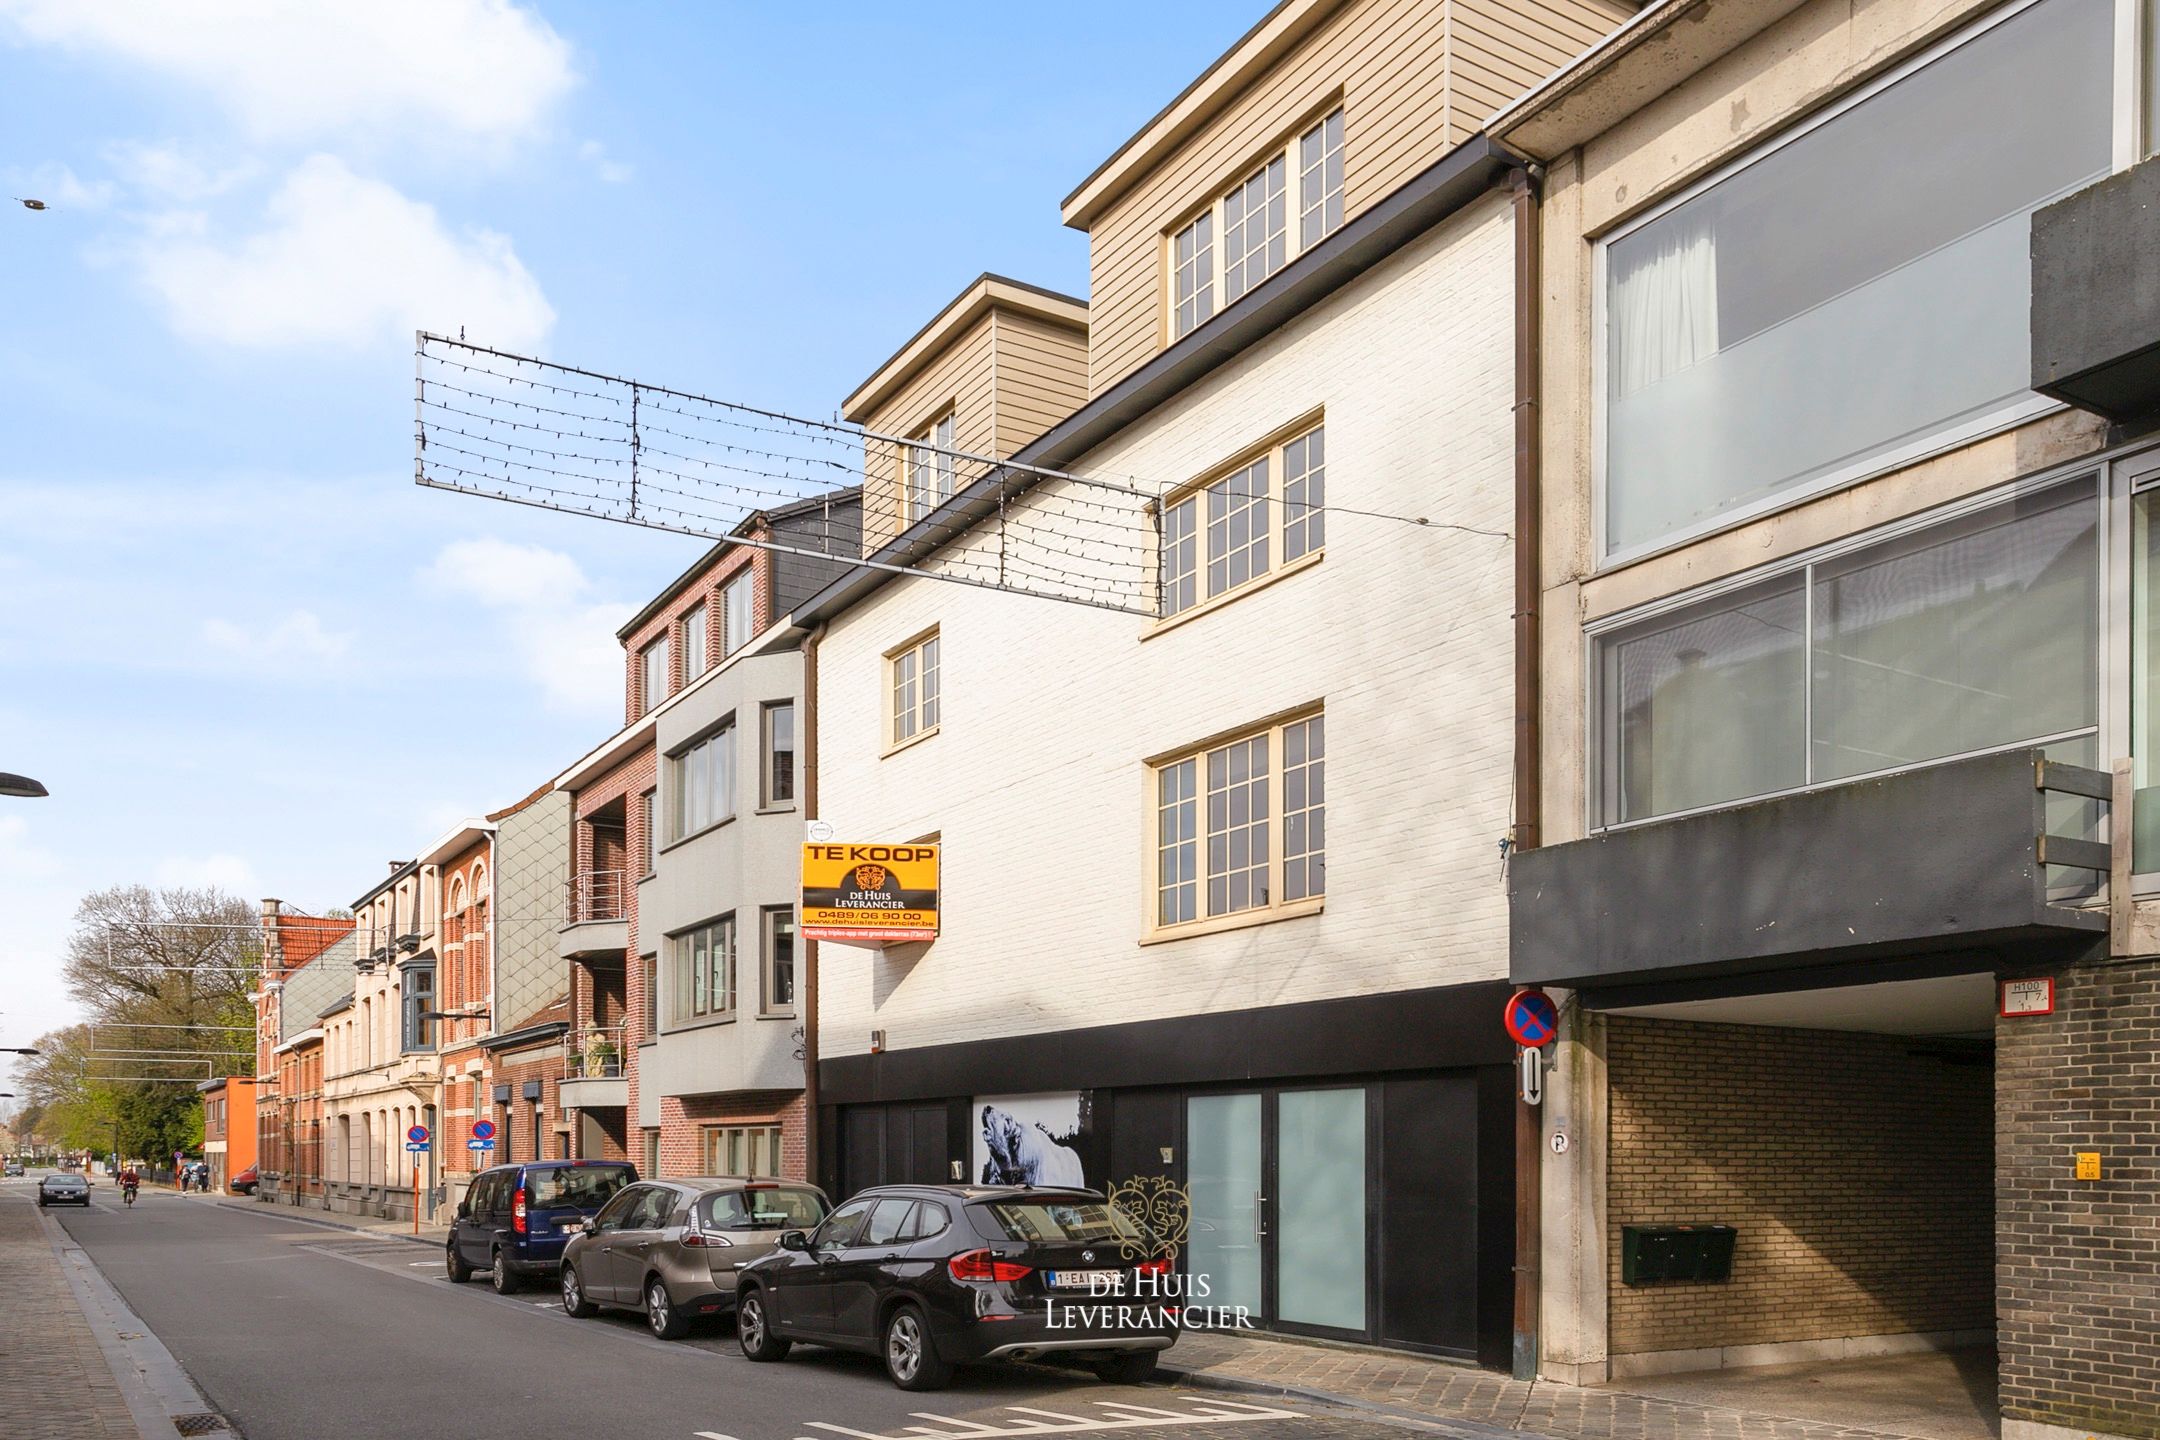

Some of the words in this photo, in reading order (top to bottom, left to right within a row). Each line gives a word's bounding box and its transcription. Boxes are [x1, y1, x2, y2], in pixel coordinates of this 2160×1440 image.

[807, 845, 844, 860] TE
[850, 846, 934, 862] KOOP
[849, 891, 864, 900] DE
[864, 890, 892, 901] HUIS
[835, 898, 905, 909] LEVERANCIER
[818, 911, 879, 919] 0489/06
[882, 912, 900, 920] 90
[903, 912, 922, 920] 00
[2014, 981, 2040, 991] H100
